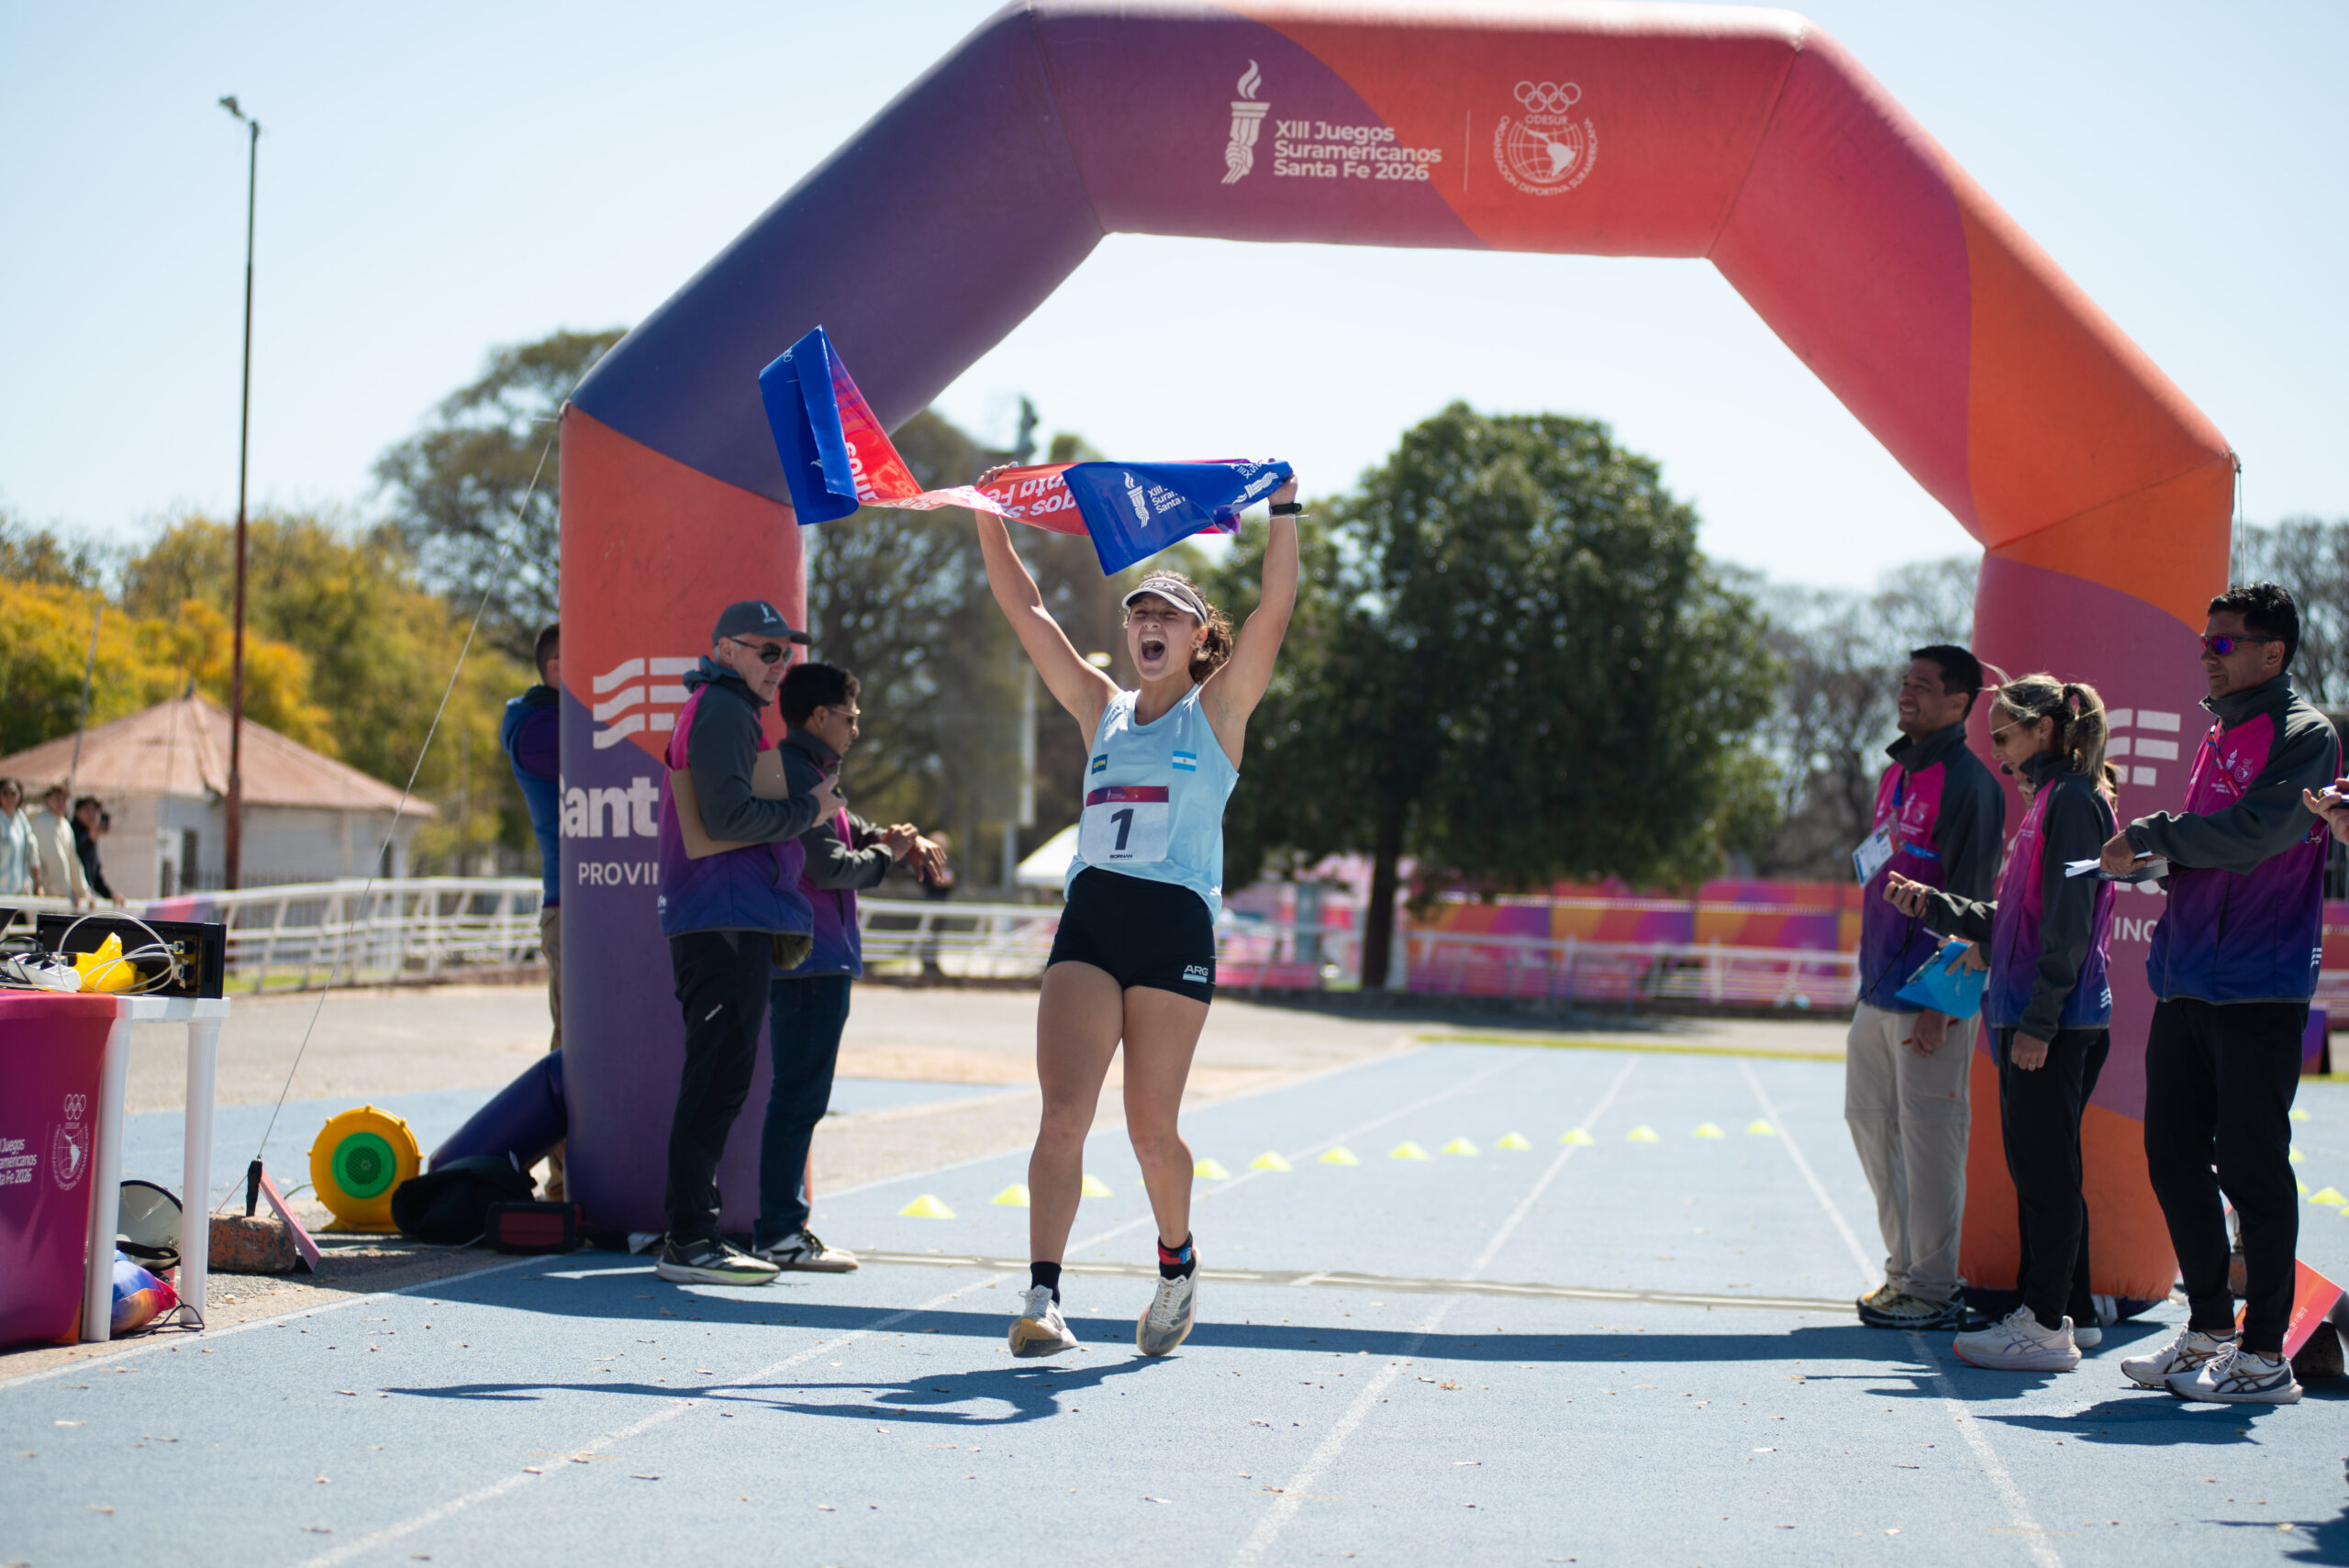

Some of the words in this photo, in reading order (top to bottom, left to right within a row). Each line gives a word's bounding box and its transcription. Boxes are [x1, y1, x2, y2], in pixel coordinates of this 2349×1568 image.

[1525, 114, 1567, 126] ODESUR
[1275, 120, 1309, 139] XIII
[1314, 121, 1395, 145] Juegos
[1274, 139, 1442, 162] Suramericanos
[1274, 159, 1337, 178] Santa
[1343, 161, 1370, 178] Fe
[1375, 162, 1430, 181] 2026
[1147, 485, 1163, 498] XIII
[1156, 497, 1182, 514] Santa
[560, 773, 659, 839] ant
[1110, 808, 1134, 851] 1
[1184, 964, 1208, 976] ARG
[2, 1138, 25, 1155] Juegos
[6, 1170, 15, 1184] Fe
[15, 1168, 33, 1184] 2026
